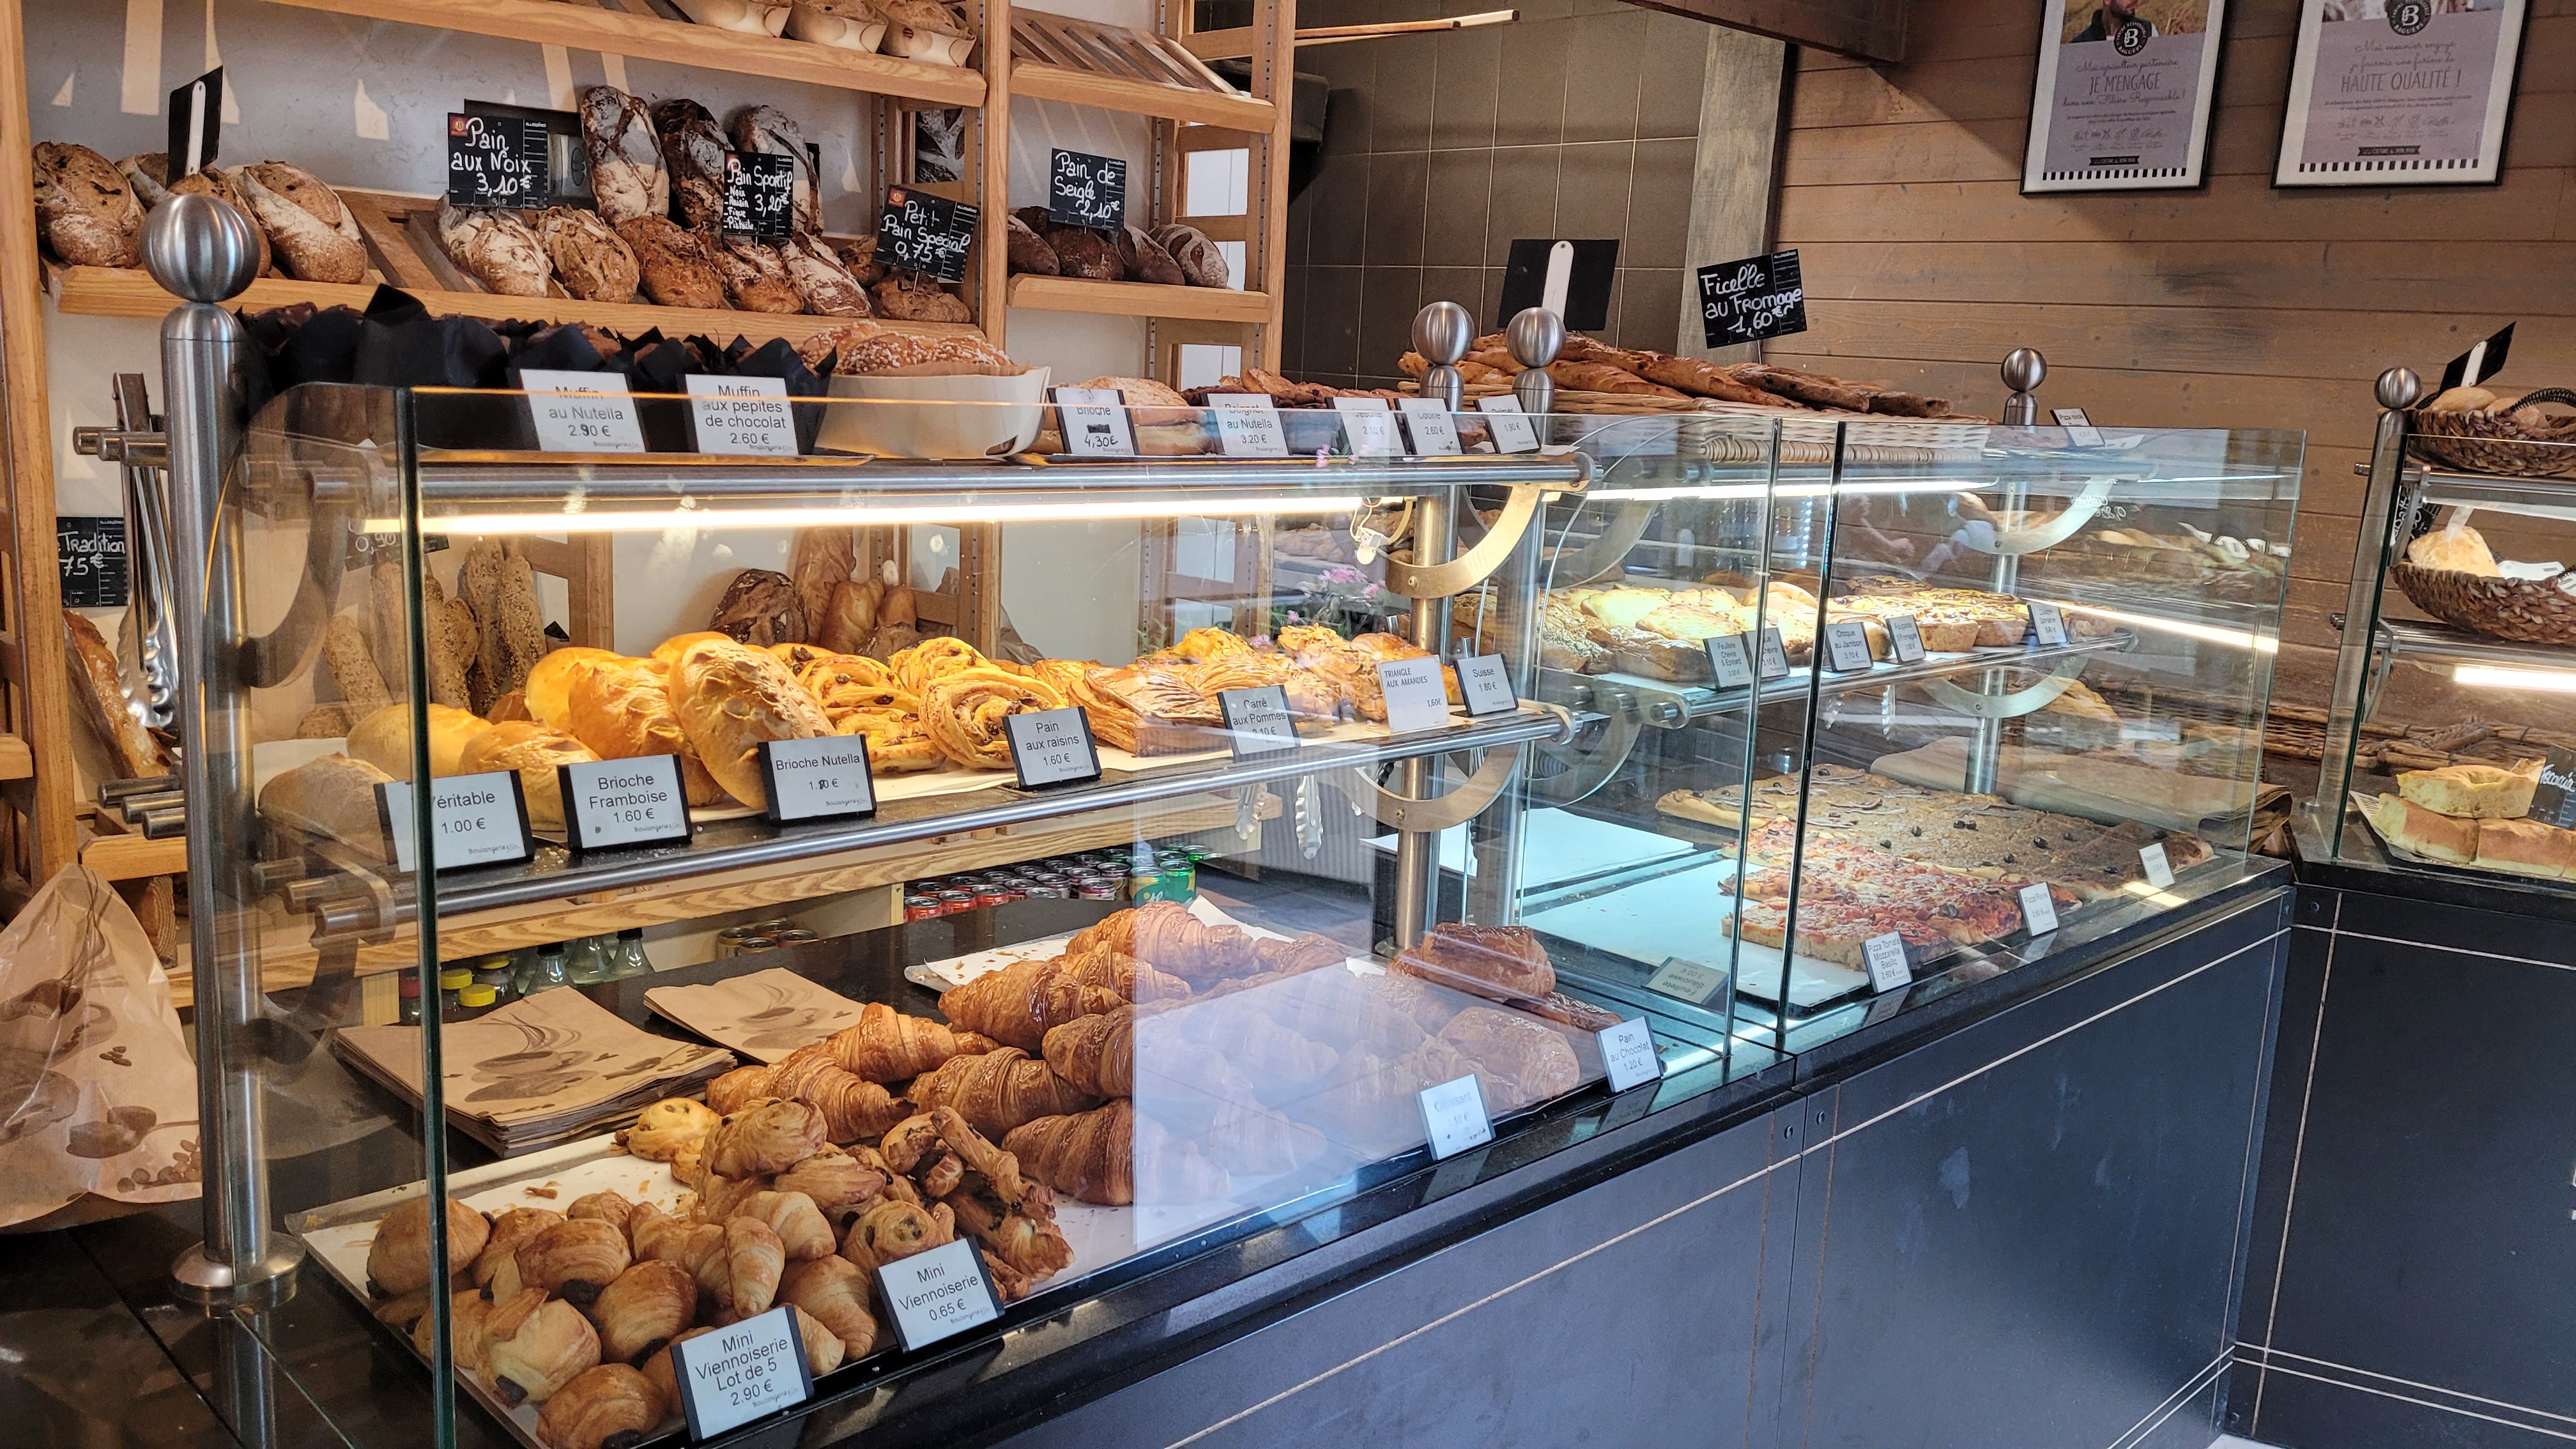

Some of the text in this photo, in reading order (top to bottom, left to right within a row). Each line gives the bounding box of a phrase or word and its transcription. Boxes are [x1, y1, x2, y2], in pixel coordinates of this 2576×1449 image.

[2089, 72, 2162, 96] JE M'ENGAGE
[2341, 73, 2385, 93] HAUTE
[2391, 66, 2451, 90] QUALITÉ
[465, 117, 509, 151] Pain
[451, 150, 532, 172] aux Noix
[1055, 151, 1116, 185] Pain de
[727, 158, 793, 194] Pain Sportif
[477, 172, 532, 197] 3,10€
[1054, 176, 1096, 208] Seigle
[905, 200, 940, 227] Petit
[880, 214, 912, 240] Pain
[1700, 263, 1765, 296] Ficelle
[1705, 302, 1729, 319] au
[718, 385, 760, 397] Muffin
[548, 406, 624, 420] au Nutella
[702, 400, 783, 415] aux pepites
[1077, 406, 1111, 415] Brioche
[705, 414, 786, 429] de chocolat
[1241, 418, 1273, 429] Nutella
[1516, 422, 1521, 431] €
[568, 424, 611, 437] 2.90 €
[1362, 426, 1385, 435] 2.10 €
[1439, 427, 1445, 435] €
[730, 433, 770, 445] 2.60 €
[1084, 434, 1119, 448] 4,30€
[1241, 434, 1268, 443] 3.20 €
[1843, 640, 1863, 648] Jambon
[1384, 668, 1412, 678] TRIANGLE
[1473, 668, 1494, 678] Suisse
[1386, 676, 1428, 688] AUX AMANDES
[1492, 681, 1497, 690] €
[1243, 698, 1268, 709] Carré
[1427, 698, 1442, 707] 1,60€
[1232, 712, 1286, 726] aux Pommes
[1036, 721, 1059, 734] Pain
[1271, 726, 1277, 735] €
[1025, 735, 1080, 751] aux raisins
[776, 753, 861, 770] Brioche Nutella
[1043, 753, 1071, 766] 1.60 €
[598, 774, 654, 790] Brioche
[832, 778, 839, 788] €
[433, 790, 496, 809] éritable
[589, 790, 668, 809] Framboise
[825, 799, 857, 807] Boulangerie
[613, 808, 655, 824] 1.60 €
[441, 817, 486, 834] 1.00 €
[634, 824, 670, 833] Boulangerie
[468, 845, 506, 855] Boulangerie
[1867, 938, 1901, 953] Pizza Tomate
[1873, 947, 1901, 962] Mozzarella
[1881, 958, 1898, 969] Basilic
[1668, 973, 1705, 990] Saucisse
[1618, 1032, 1635, 1045] Pain
[1610, 1040, 1650, 1062] au Chocolat
[1638, 1057, 1643, 1066] €
[1434, 1091, 1472, 1112] Croissant
[1464, 1112, 1469, 1121] €
[917, 1262, 945, 1284] Mini
[898, 1275, 979, 1310] Viennoiserie
[929, 1298, 967, 1321] 0.65 €
[722, 1330, 754, 1354] Mini
[695, 1338, 788, 1379] Viennoiserie
[716, 1356, 777, 1392] Lot de 5
[730, 1379, 774, 1406] 2.90 €
[753, 1390, 788, 1408] Boulangerie
